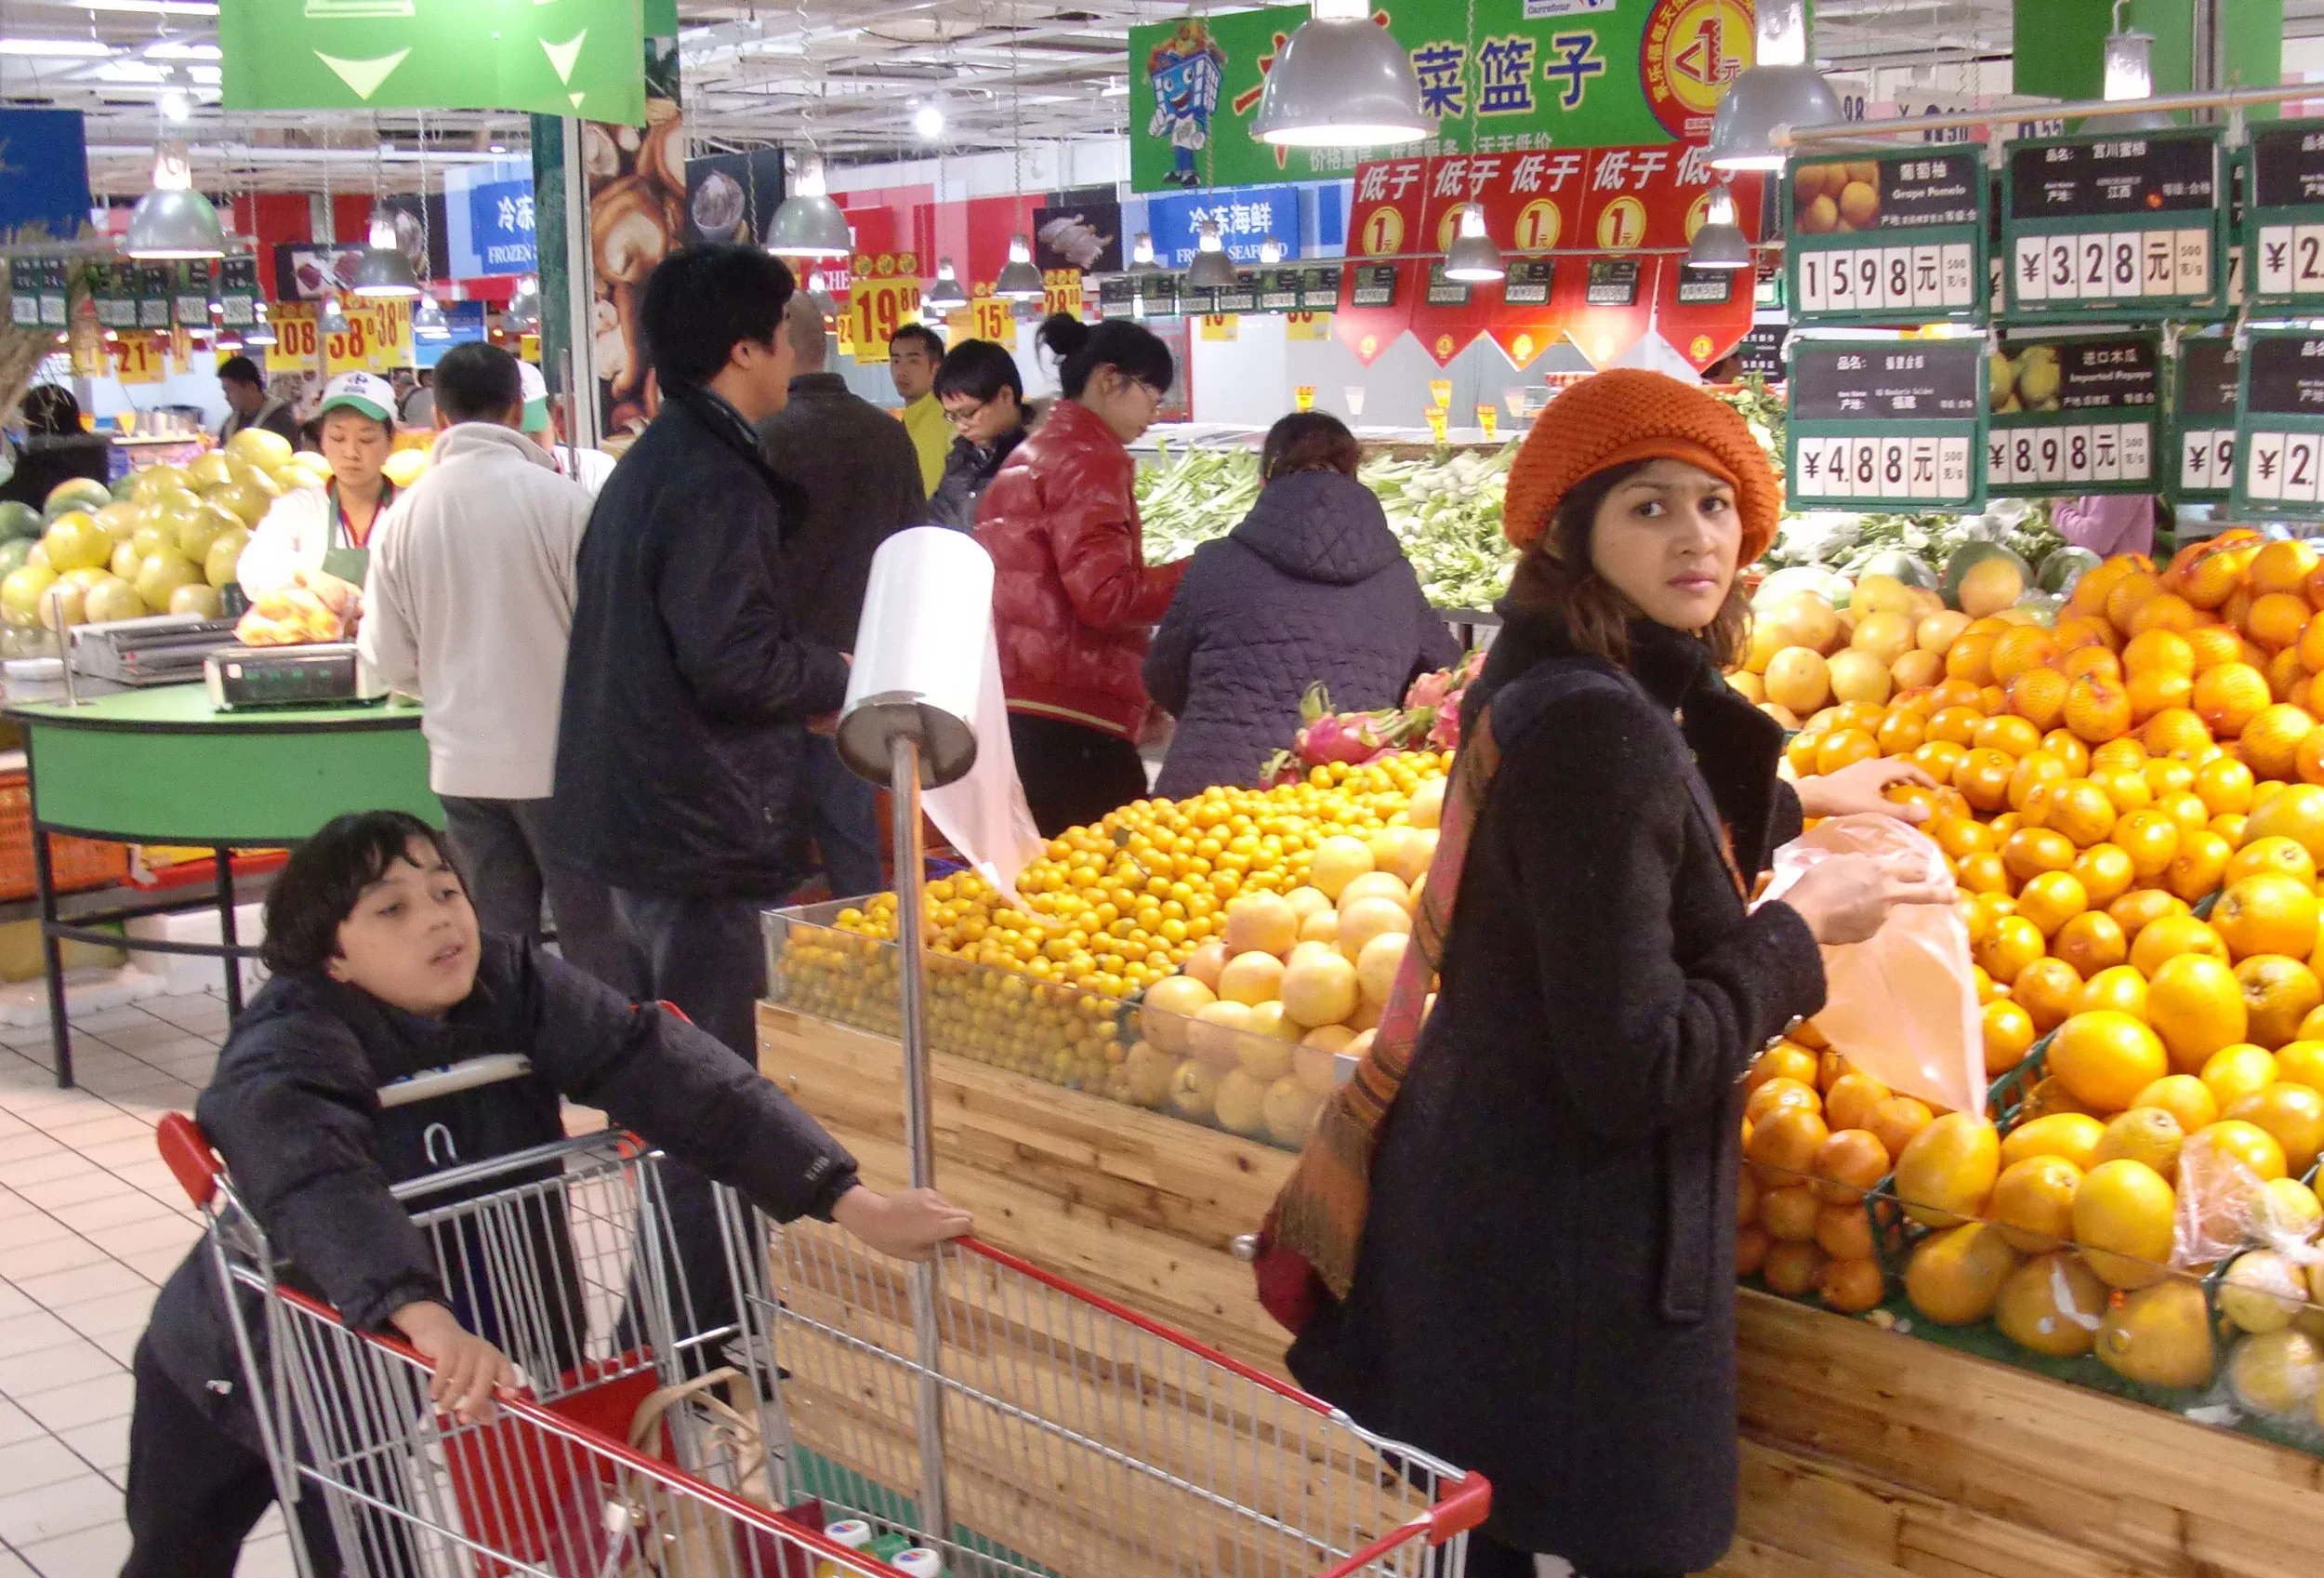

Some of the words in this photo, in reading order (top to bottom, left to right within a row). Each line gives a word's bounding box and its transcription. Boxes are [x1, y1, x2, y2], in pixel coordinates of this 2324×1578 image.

[1527, 3, 1571, 14] Carrefour
[1411, 33, 1604, 119] 菜篮子
[1358, 163, 1421, 203] 低于
[1433, 159, 1501, 198] 低于
[1510, 153, 1581, 193] 低于
[1592, 151, 1670, 192] 低于
[1892, 188, 1925, 202] Grape
[1927, 184, 1966, 197] Pomelo
[488, 244, 532, 265] FROZEN
[856, 288, 899, 344] 19
